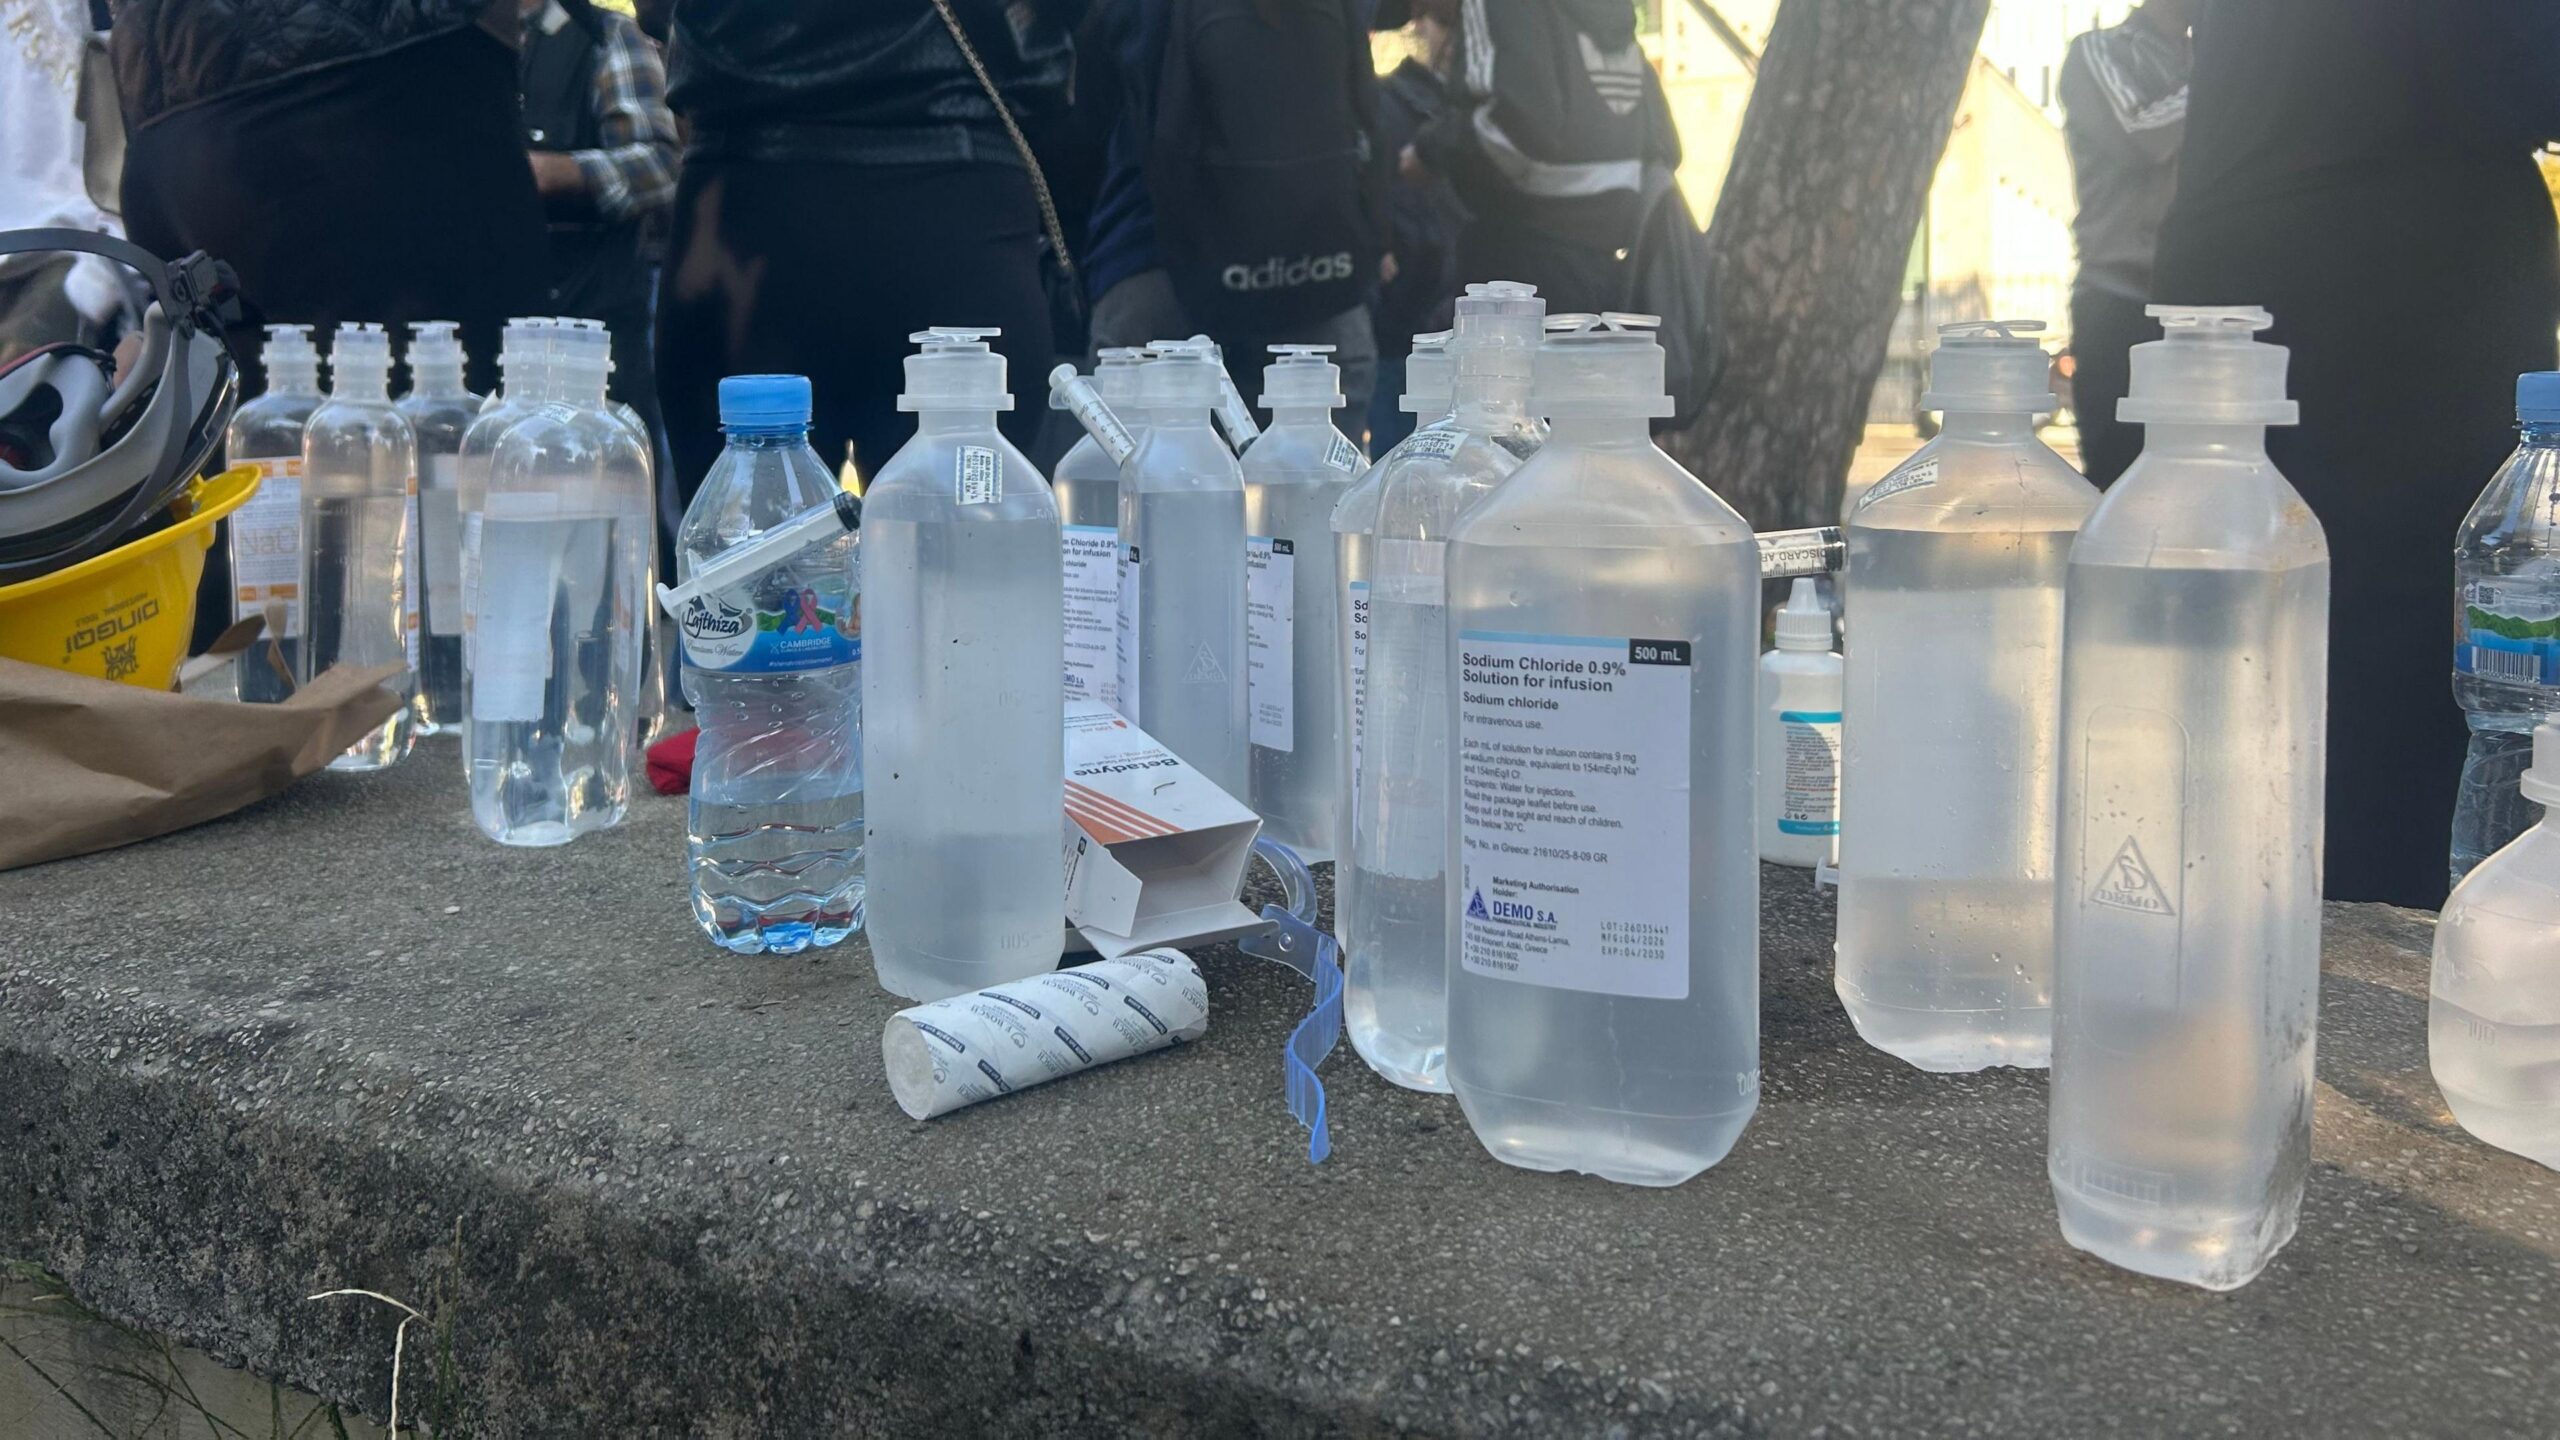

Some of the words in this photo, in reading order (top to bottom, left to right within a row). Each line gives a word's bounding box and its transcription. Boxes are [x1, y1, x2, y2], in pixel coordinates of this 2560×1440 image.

[1222, 252, 1353, 290] adidas
[1070, 538, 1099, 547] Chloride
[1072, 548, 1081, 556] for
[1082, 549, 1111, 558] infusion
[1780, 548, 1826, 561] DISCARD
[685, 606, 740, 639] Lajthiza
[780, 637, 832, 649] CAMBRIDGE
[1634, 646, 1657, 661] 500
[1660, 648, 1682, 662] mL
[1462, 652, 1515, 669] Sodium
[1518, 657, 1584, 674] Chloride
[1588, 661, 1627, 677] 0.9%
[1462, 669, 1519, 687] Solution
[1523, 674, 1546, 689] for
[1549, 677, 1613, 693] infusion
[1463, 691, 1505, 706] Sodium
[1508, 696, 1559, 711] chloride
[1463, 712, 1475, 724] For
[1476, 714, 1523, 729] intravenous
[1525, 719, 1544, 730] use.
[1464, 738, 1479, 749] Each
[1492, 742, 1501, 751] of
[1502, 744, 1532, 755] solution
[1533, 746, 1544, 756] for
[1545, 747, 1577, 759] infusion
[1578, 751, 1613, 762] contains
[1614, 752, 1621, 761] 9
[1622, 754, 1637, 765] mg
[1074, 758, 1180, 776] Betadyne
[1464, 764, 1476, 774] and
[1470, 753, 1495, 764] sodium
[1496, 757, 1529, 769] chloride,
[1529, 760, 1571, 772] equivalent
[1572, 763, 1581, 772] to
[1500, 782, 1522, 794] Water
[1524, 784, 1535, 794] for
[1537, 785, 1576, 798] injections.
[1464, 789, 1480, 801] Read
[1481, 791, 1493, 801] the
[1493, 793, 1526, 808] package
[1527, 797, 1551, 809] leaflet
[1552, 800, 1579, 812] before
[1580, 804, 1598, 813] use.
[1464, 802, 1480, 815] Keep
[1481, 805, 1492, 815] out
[1493, 807, 1501, 816] of
[1502, 807, 1514, 818] the
[1516, 809, 1535, 823] sight
[1537, 812, 1551, 822] and
[1553, 814, 1577, 825] reach
[1578, 816, 1587, 825] of
[1588, 817, 1623, 829] children.
[1464, 814, 1480, 826] Store
[1481, 817, 1502, 830] below
[1479, 839, 1491, 850] No.
[1492, 841, 1500, 850] in
[1501, 842, 1531, 856] Greece:
[1593, 852, 1608, 863] GR
[1492, 876, 1528, 890] Marketing
[1529, 881, 1580, 895] Authorisation
[1492, 887, 1518, 898] Holder:
[1493, 900, 1534, 921] DEMO
[1537, 910, 1558, 924] S.A.
[1481, 925, 1506, 938] National
[1507, 929, 1524, 941] Road
[1525, 943, 1548, 955] Greece
[970, 1005, 1004, 1027] BOSCH
